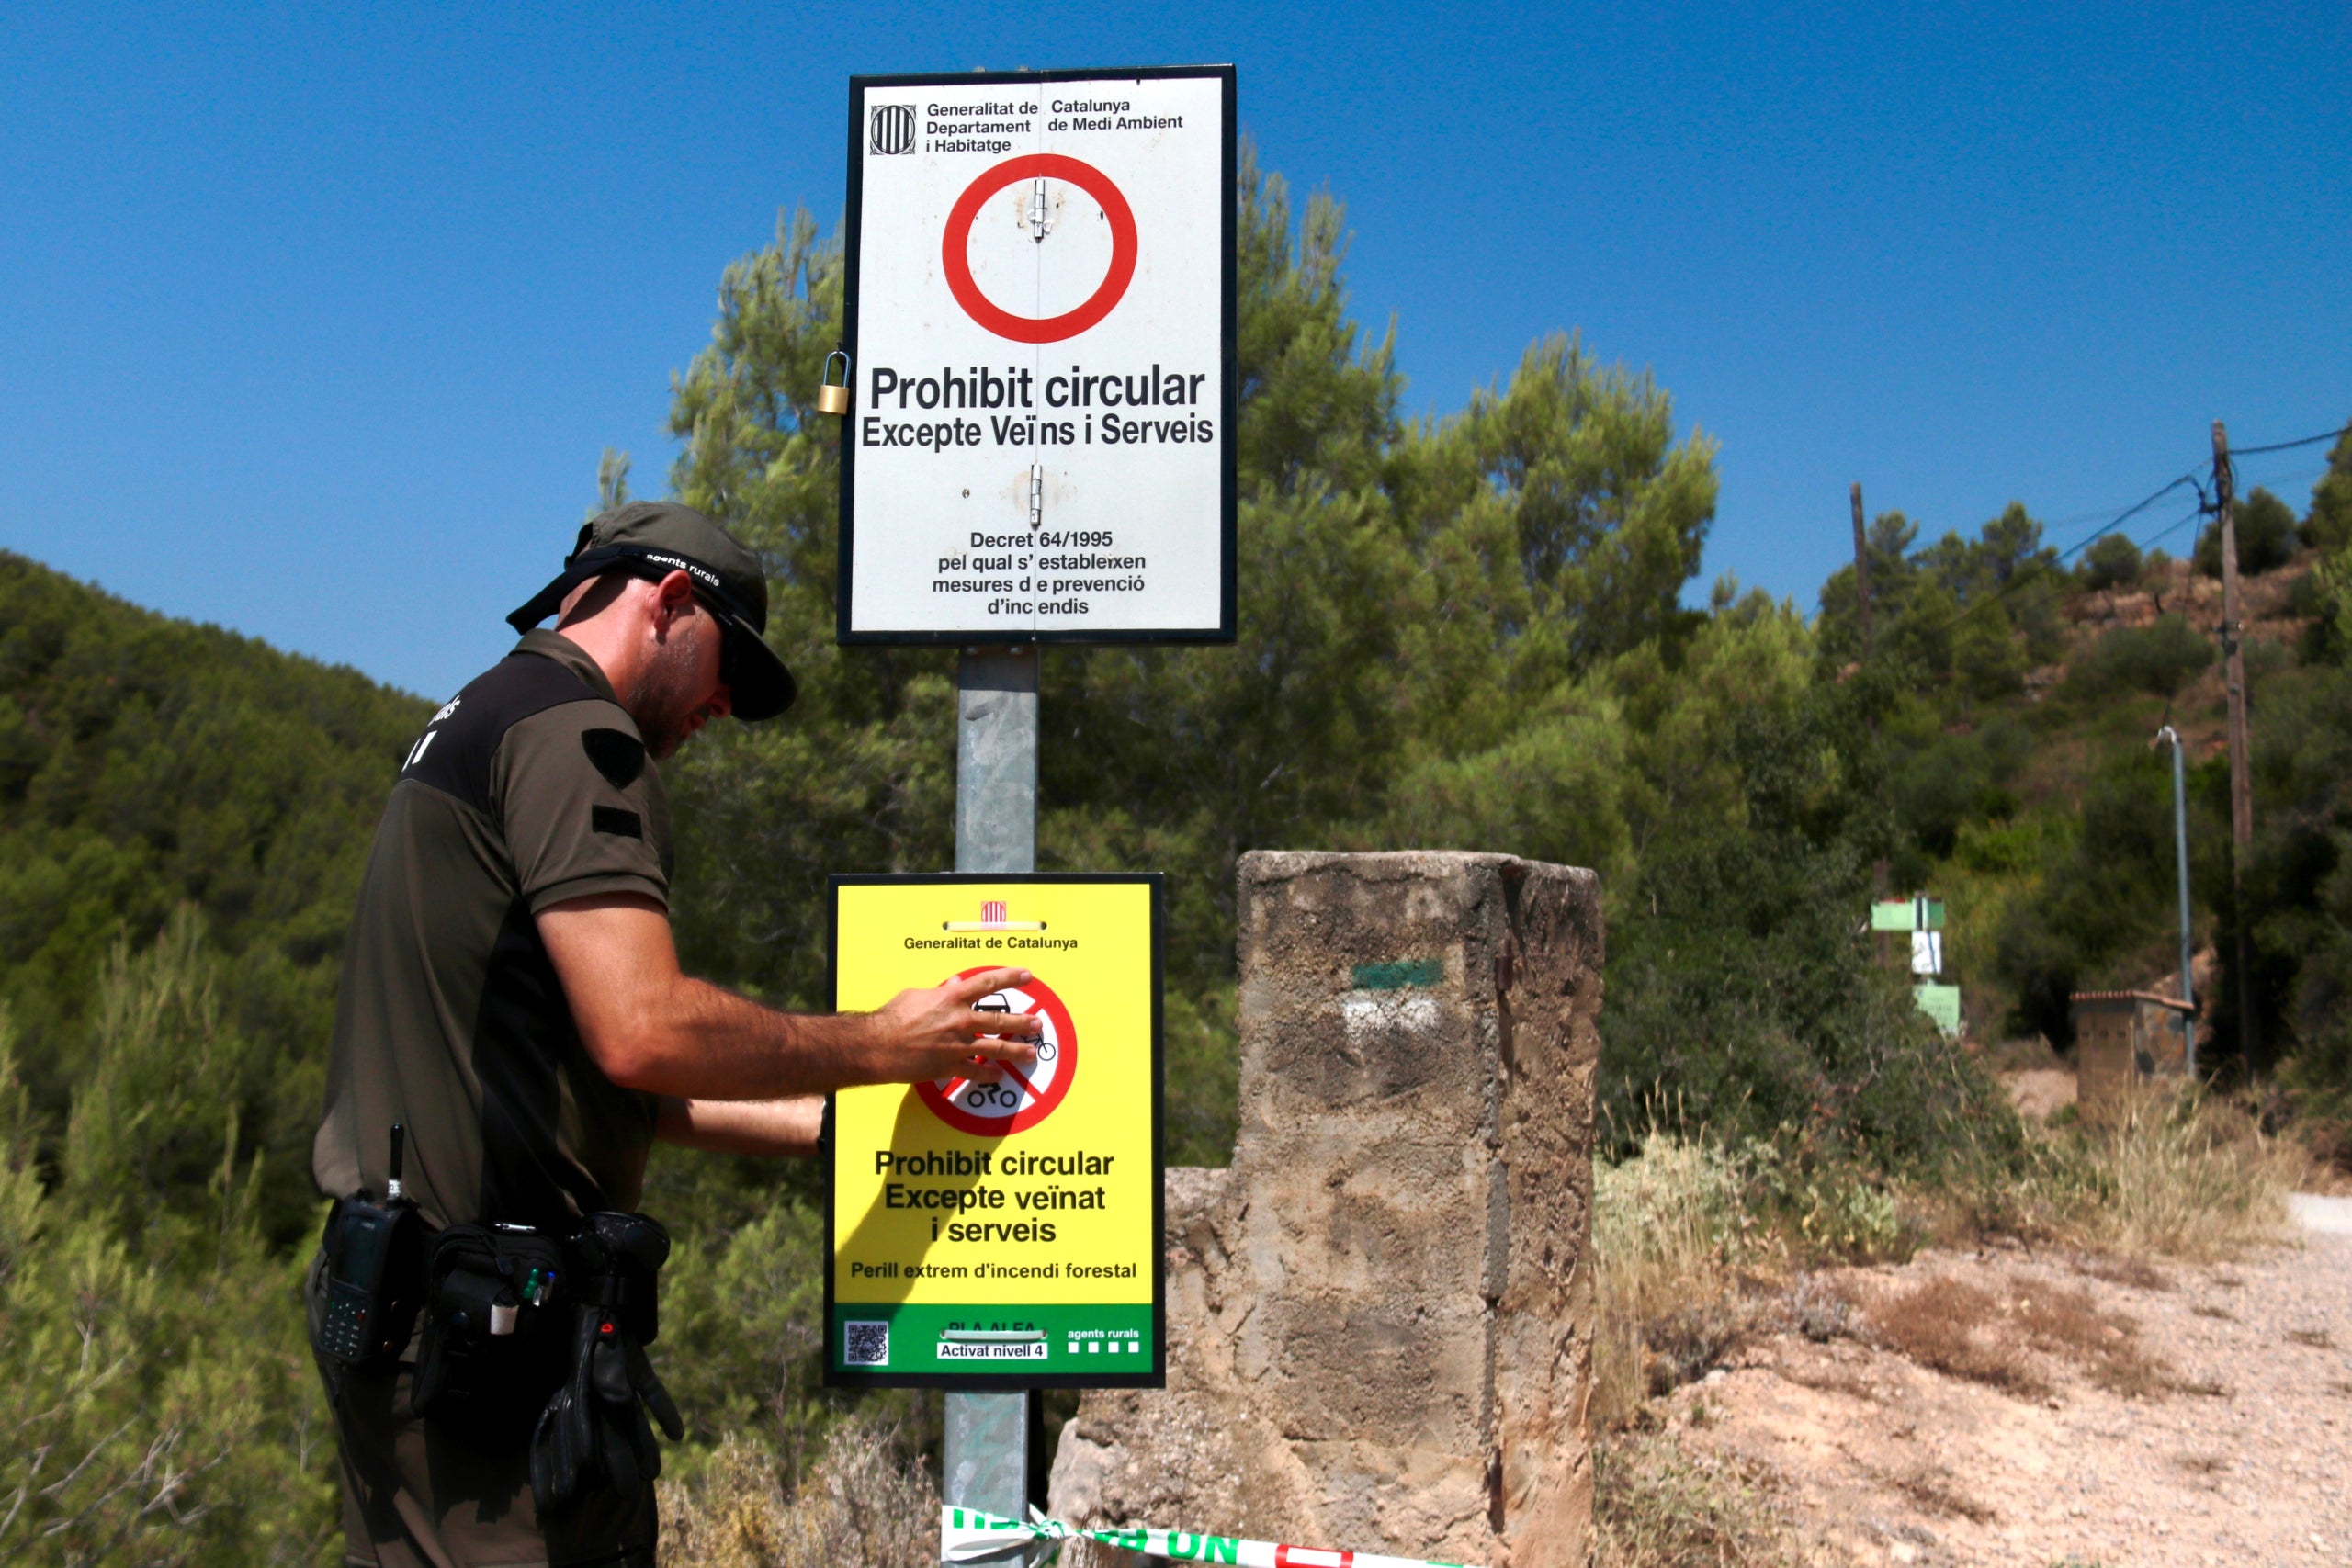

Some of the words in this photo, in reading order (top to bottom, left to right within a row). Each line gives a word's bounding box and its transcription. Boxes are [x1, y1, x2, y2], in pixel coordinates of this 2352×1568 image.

[927, 102, 1014, 117] Generalitat
[1018, 101, 1039, 115] de
[1051, 98, 1130, 115] Catalunya
[926, 119, 1031, 137] Departament
[1047, 118, 1069, 132] de
[1072, 117, 1112, 131] Medi
[1115, 115, 1183, 130] Ambient
[926, 139, 931, 152] i
[934, 139, 1012, 154] Habitatge
[871, 366, 1033, 410] Prohibit
[1045, 363, 1205, 408] circular
[862, 416, 982, 454] Excepte
[990, 414, 1075, 446] Veïns
[1085, 413, 1091, 445] i
[1101, 412, 1214, 445] Serveis
[970, 532, 1034, 548] Decret
[1039, 530, 1113, 547] 64/1995
[646, 554, 687, 569] agents
[689, 565, 719, 587] rurals
[938, 554, 967, 574] pel
[972, 553, 1012, 574] qual
[933, 580, 1013, 592] mesures
[1052, 574, 1145, 596] prevenció
[904, 937, 981, 950] Generalitat
[985, 937, 1003, 949] de
[1007, 936, 1078, 952] Catalunya
[876, 1149, 992, 1177] Prohibit
[1001, 1150, 1114, 1176] circular
[885, 1182, 1005, 1215] Excepte
[1014, 1185, 1106, 1211] veïnat
[931, 1216, 938, 1242] i
[947, 1217, 1057, 1243] serveis
[851, 1261, 899, 1279] Perill
[903, 1265, 967, 1279] extrem
[974, 1262, 1059, 1279] d'incendi
[1065, 1262, 1136, 1279] forestal
[1068, 1328, 1105, 1341] agents
[1107, 1328, 1139, 1338] rurals
[941, 1343, 991, 1357] Activat
[993, 1344, 1031, 1358] nivell
[1034, 1345, 1044, 1357] 4
